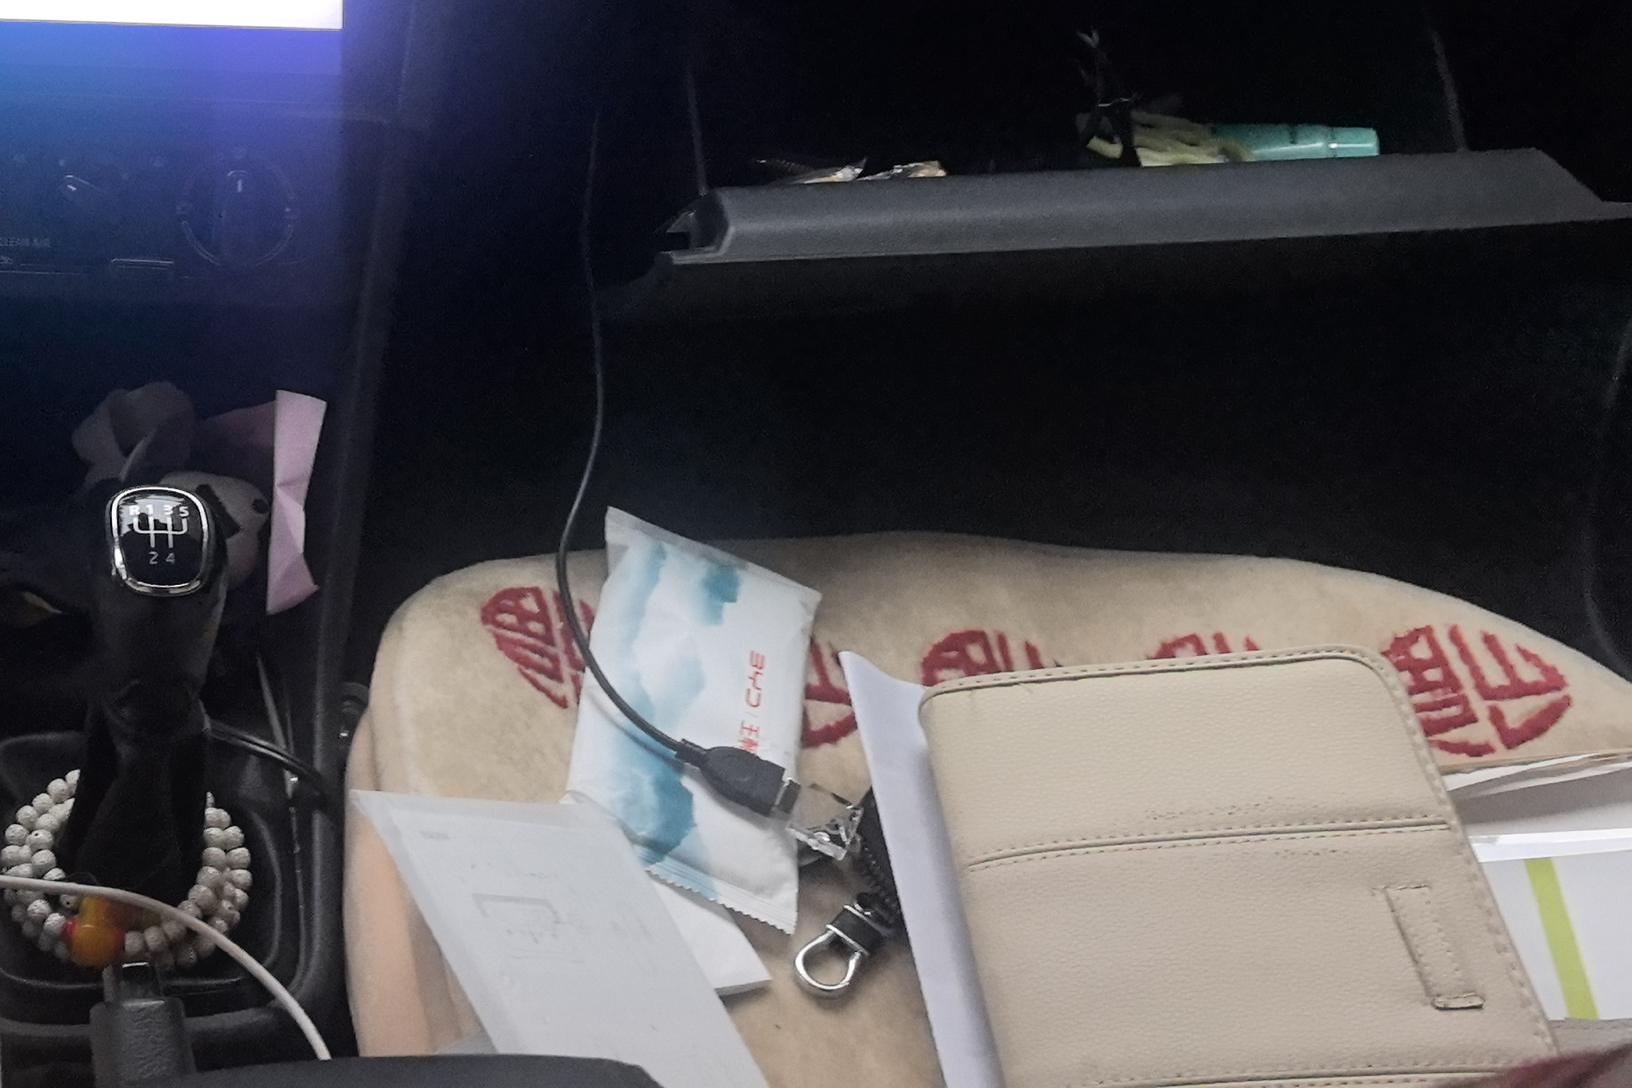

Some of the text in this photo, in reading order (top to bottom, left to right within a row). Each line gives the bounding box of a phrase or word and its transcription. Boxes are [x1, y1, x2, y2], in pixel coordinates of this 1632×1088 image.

[129, 504, 190, 518] R 1 3 5
[148, 551, 176, 565] 2 4
